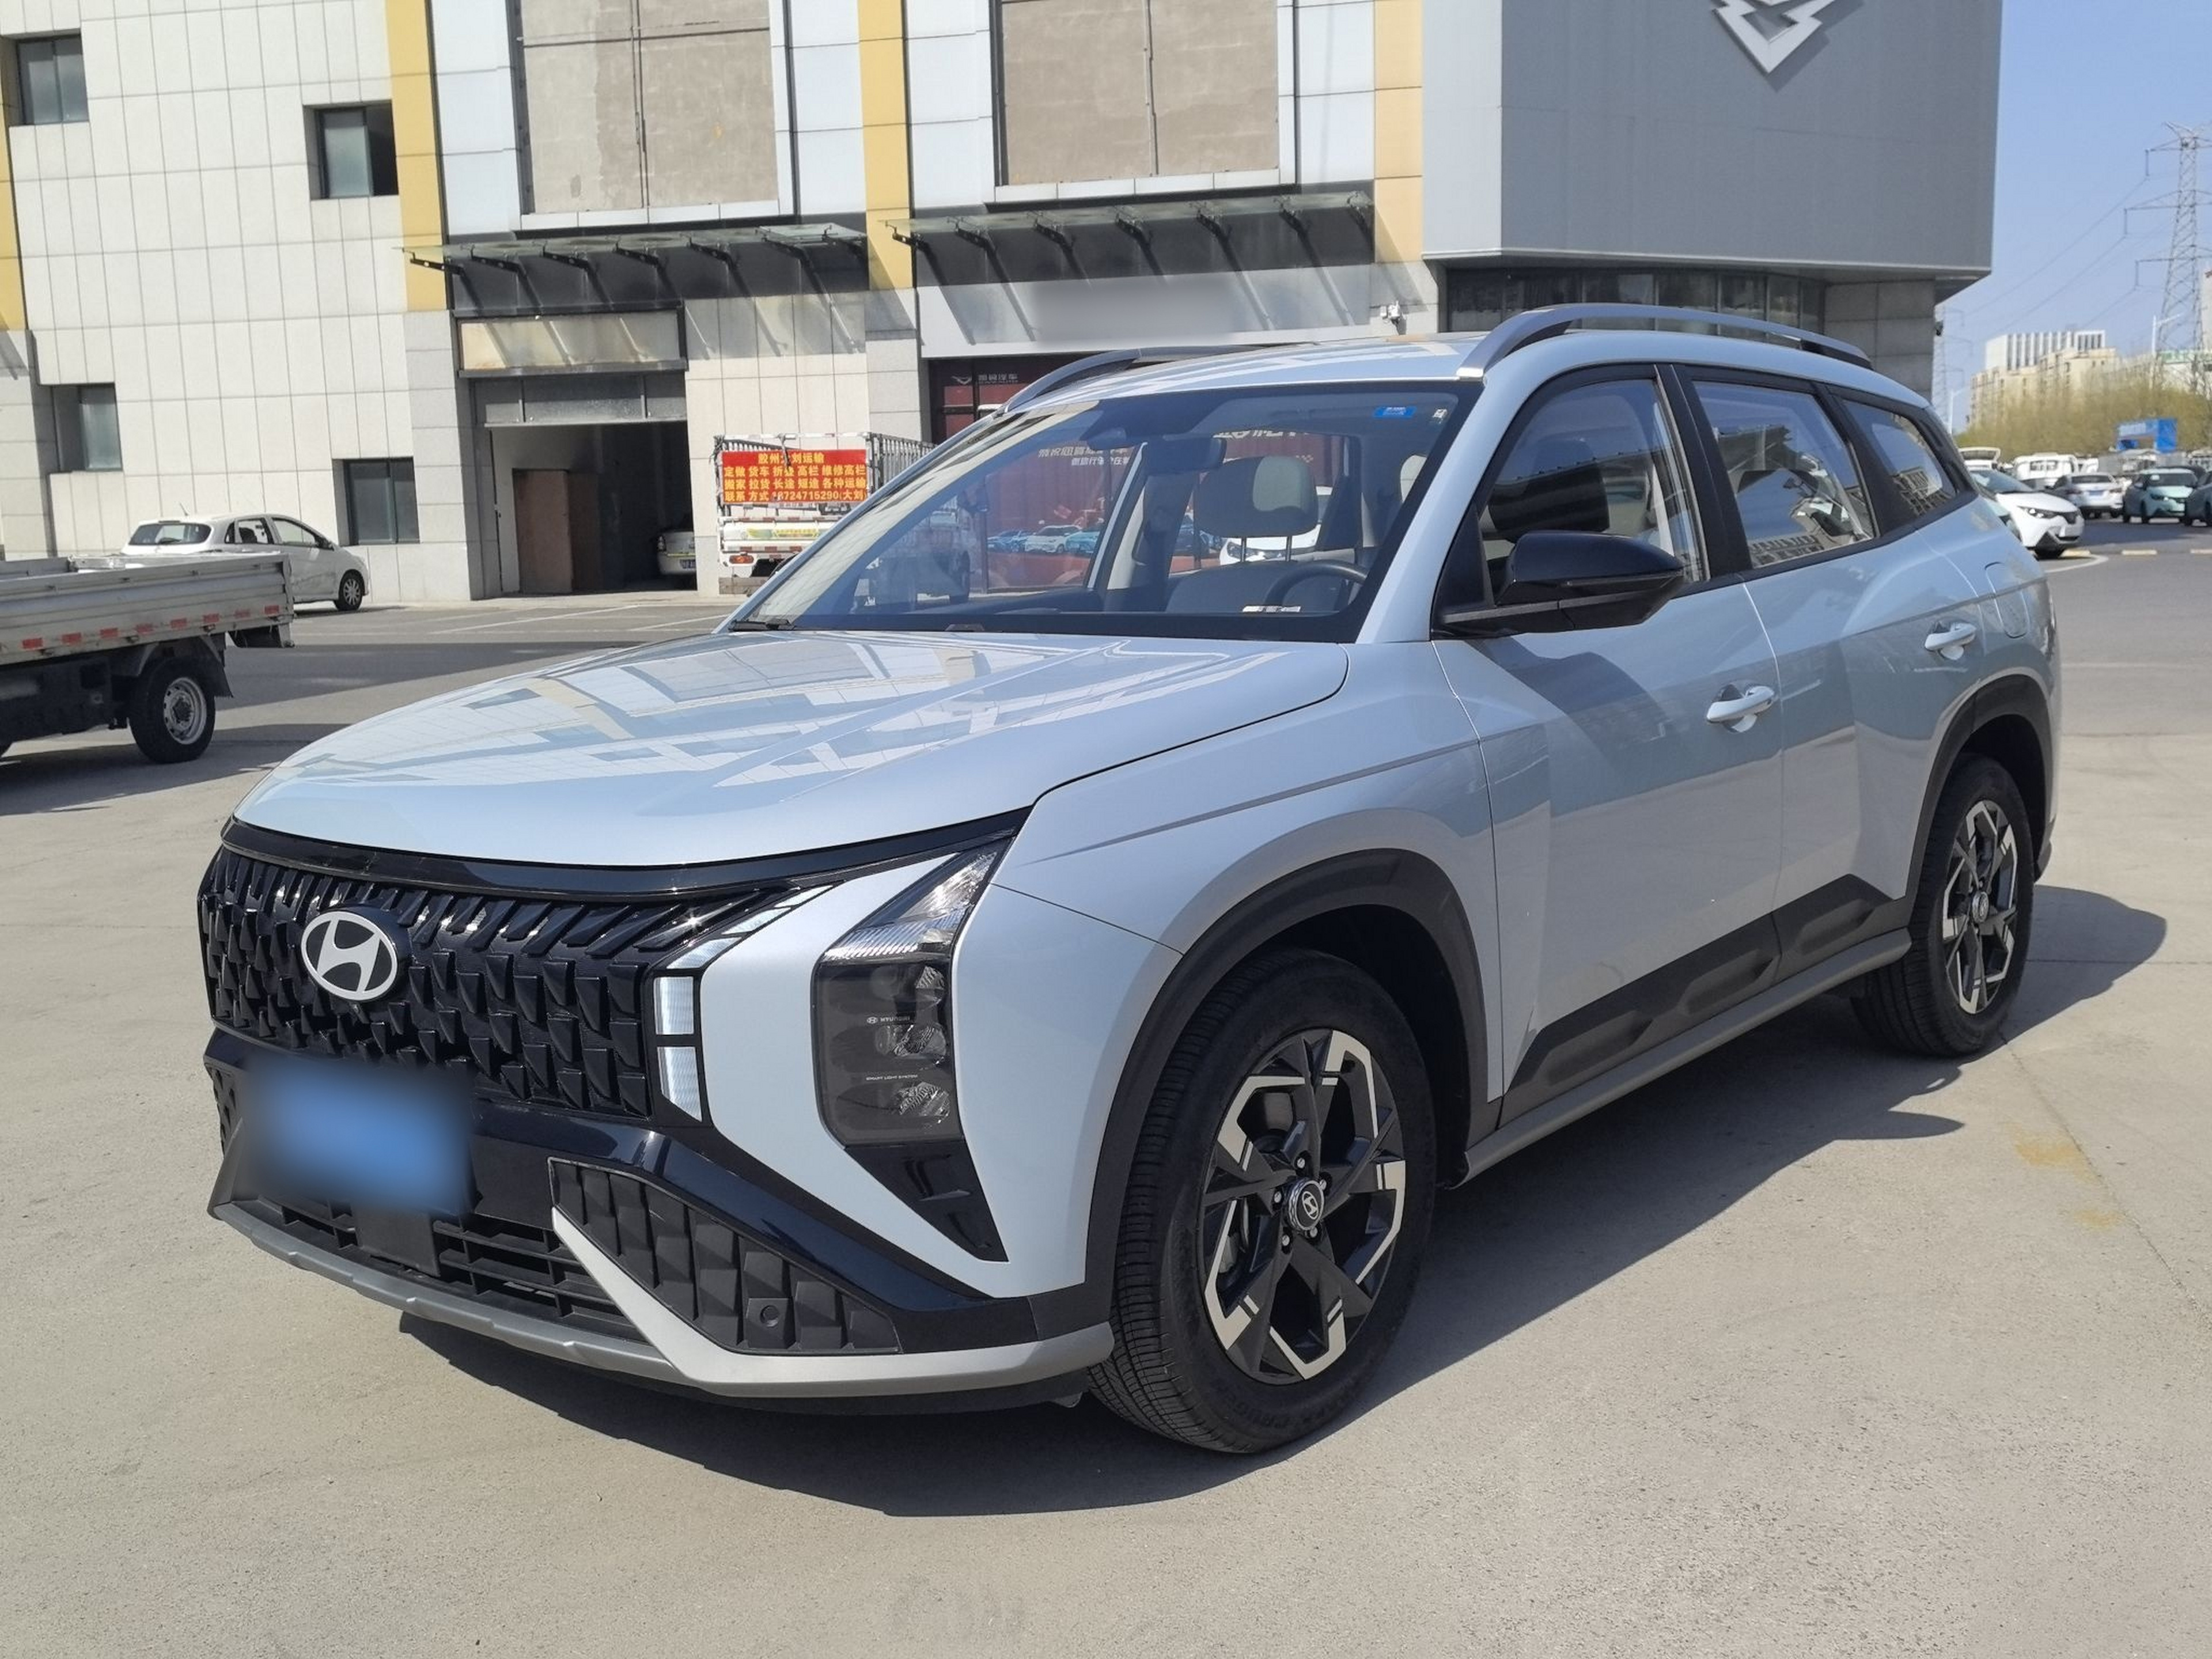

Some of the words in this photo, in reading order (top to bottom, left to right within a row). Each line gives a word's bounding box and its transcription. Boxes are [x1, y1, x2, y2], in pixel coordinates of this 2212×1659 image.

[749, 466, 770, 477] 货车
[797, 465, 819, 476] 高栏
[724, 479, 745, 490] 搬家
[773, 478, 795, 489] 长途
[798, 478, 819, 488] 短途
[823, 476, 866, 488] 各种运输
[724, 491, 745, 501] 联系
[748, 490, 770, 501] 方式
